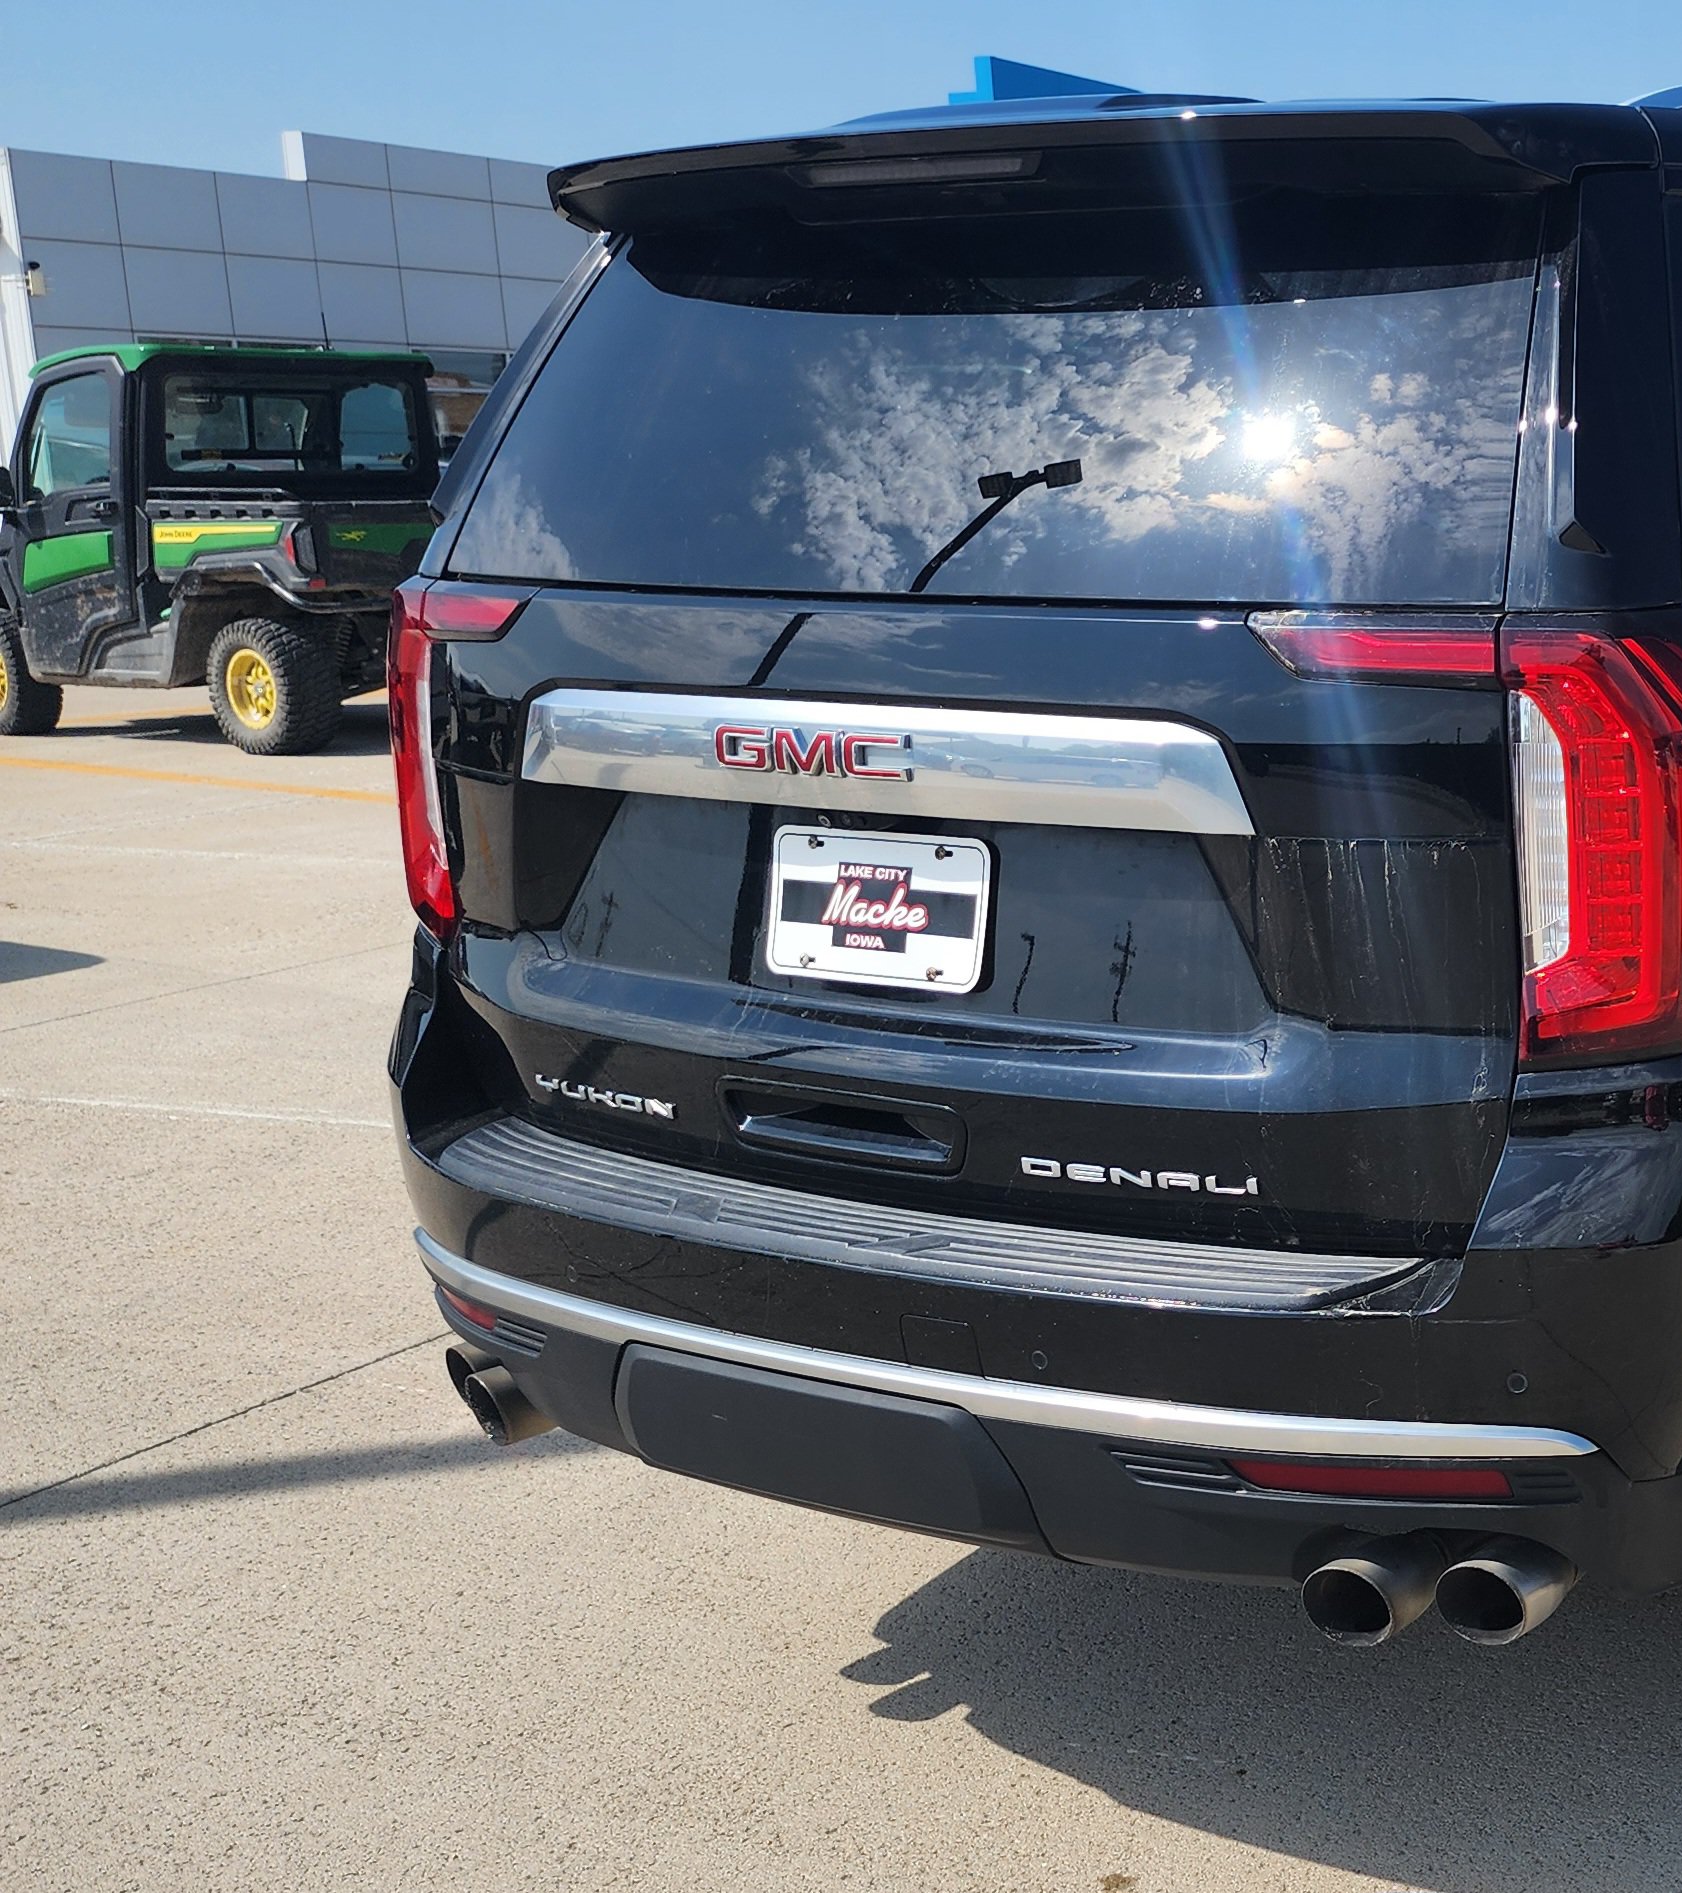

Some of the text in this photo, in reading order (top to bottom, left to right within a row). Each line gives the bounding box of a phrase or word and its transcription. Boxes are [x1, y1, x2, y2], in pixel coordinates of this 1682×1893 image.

[715, 723, 914, 783] GMC
[840, 864, 907, 881] LAKE CITY
[821, 879, 929, 932] Macke
[845, 933, 886, 949] IOWA
[535, 1073, 677, 1120] YUKON
[1020, 1156, 1260, 1196] DENALI
